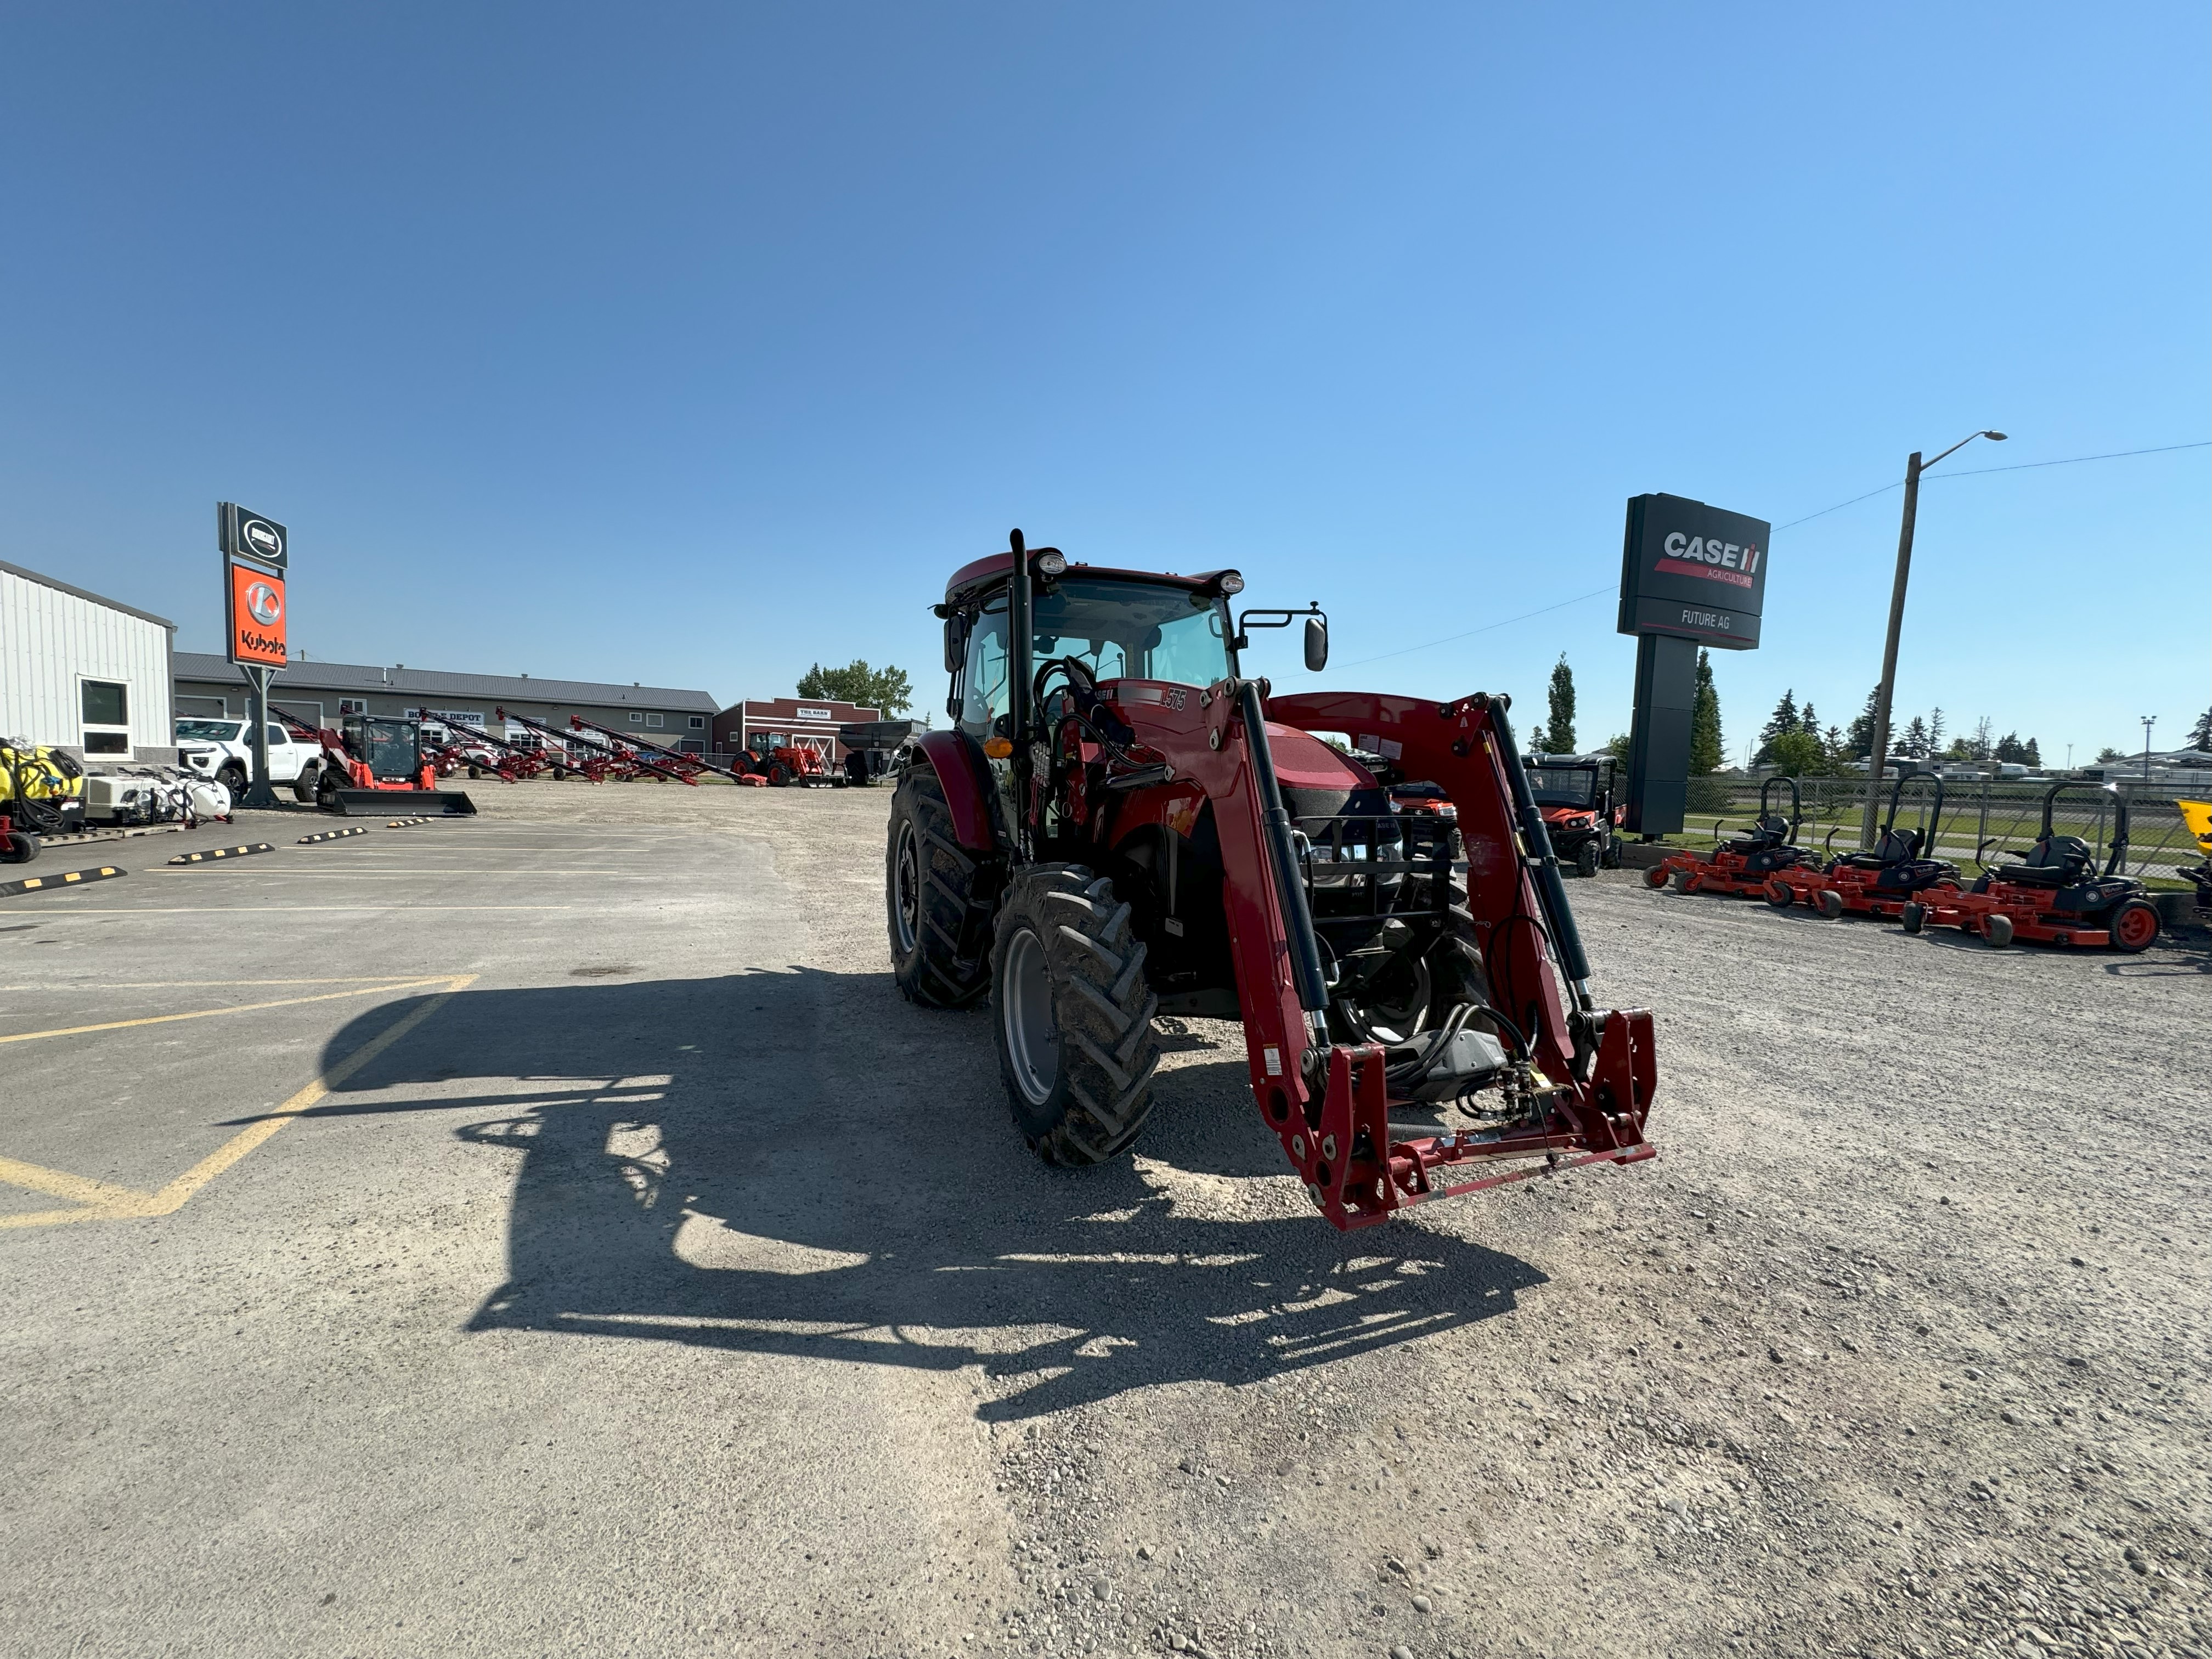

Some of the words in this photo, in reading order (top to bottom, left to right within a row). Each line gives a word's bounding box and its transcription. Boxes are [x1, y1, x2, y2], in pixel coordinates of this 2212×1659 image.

[1664, 532, 1740, 568] CASE
[1707, 569, 1752, 586] AGRICULTURE
[1681, 610, 1717, 627] FUTURE
[1717, 616, 1730, 630] AG
[241, 630, 286, 656] Kubota
[1160, 687, 1187, 712] L575
